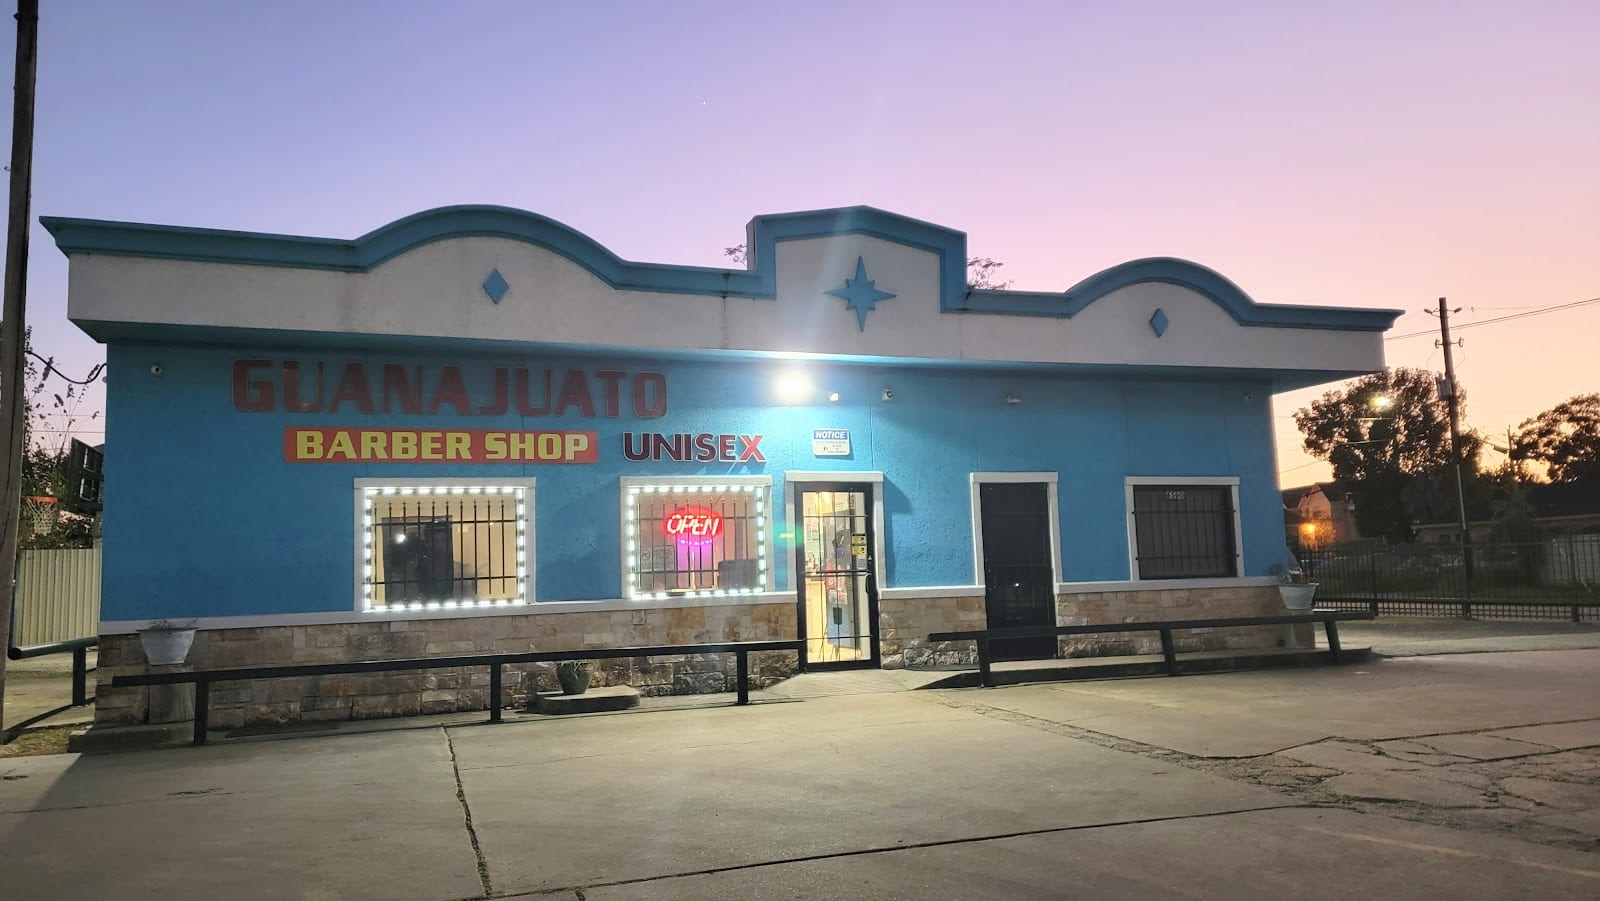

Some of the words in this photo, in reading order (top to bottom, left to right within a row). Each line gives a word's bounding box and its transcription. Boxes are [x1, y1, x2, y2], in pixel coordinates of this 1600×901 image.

[233, 358, 668, 419] GUANAJUATO
[297, 430, 472, 460] BARBER
[484, 432, 589, 460] SHOP
[622, 431, 767, 462] UNISEX
[815, 430, 846, 439] NOTICE
[666, 514, 719, 536] OPEN
